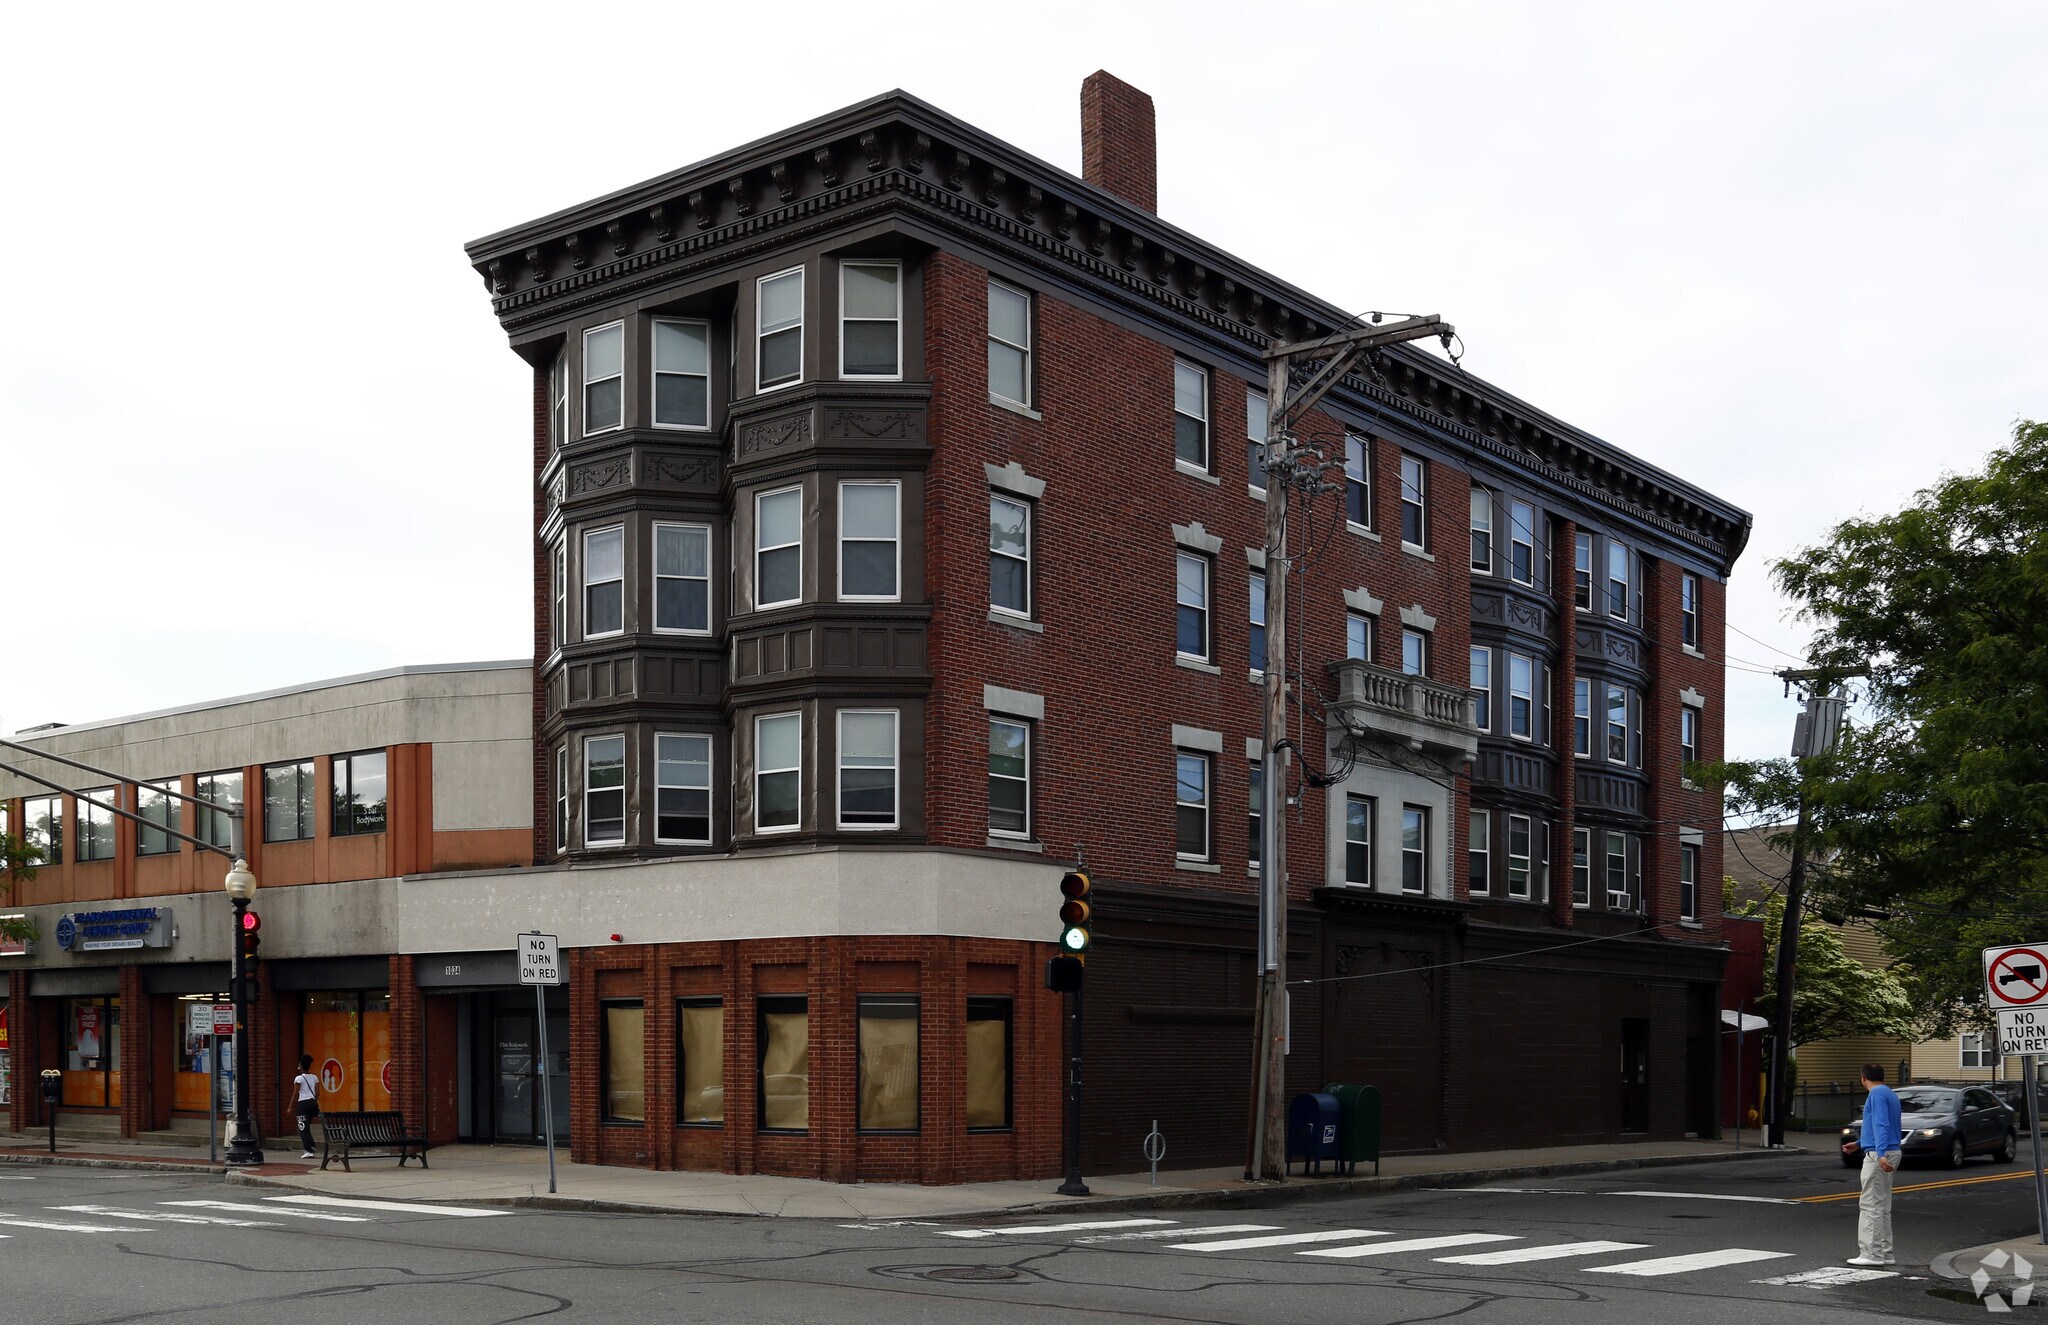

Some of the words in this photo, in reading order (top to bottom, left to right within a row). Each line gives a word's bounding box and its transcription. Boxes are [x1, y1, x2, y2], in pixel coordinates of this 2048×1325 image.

[356, 814, 385, 825] Bodywork
[74, 907, 158, 924] TRANSCONTINENTAL
[82, 925, 119, 937] LENDING
[120, 922, 149, 936] GROUP
[530, 940, 546, 950] NO
[527, 954, 551, 965] TURN
[523, 968, 535, 978] ON
[539, 968, 556, 979] RED
[2015, 1012, 2034, 1025] NO
[2006, 1025, 2046, 1039] TURN
[2002, 1040, 2021, 1052] ON
